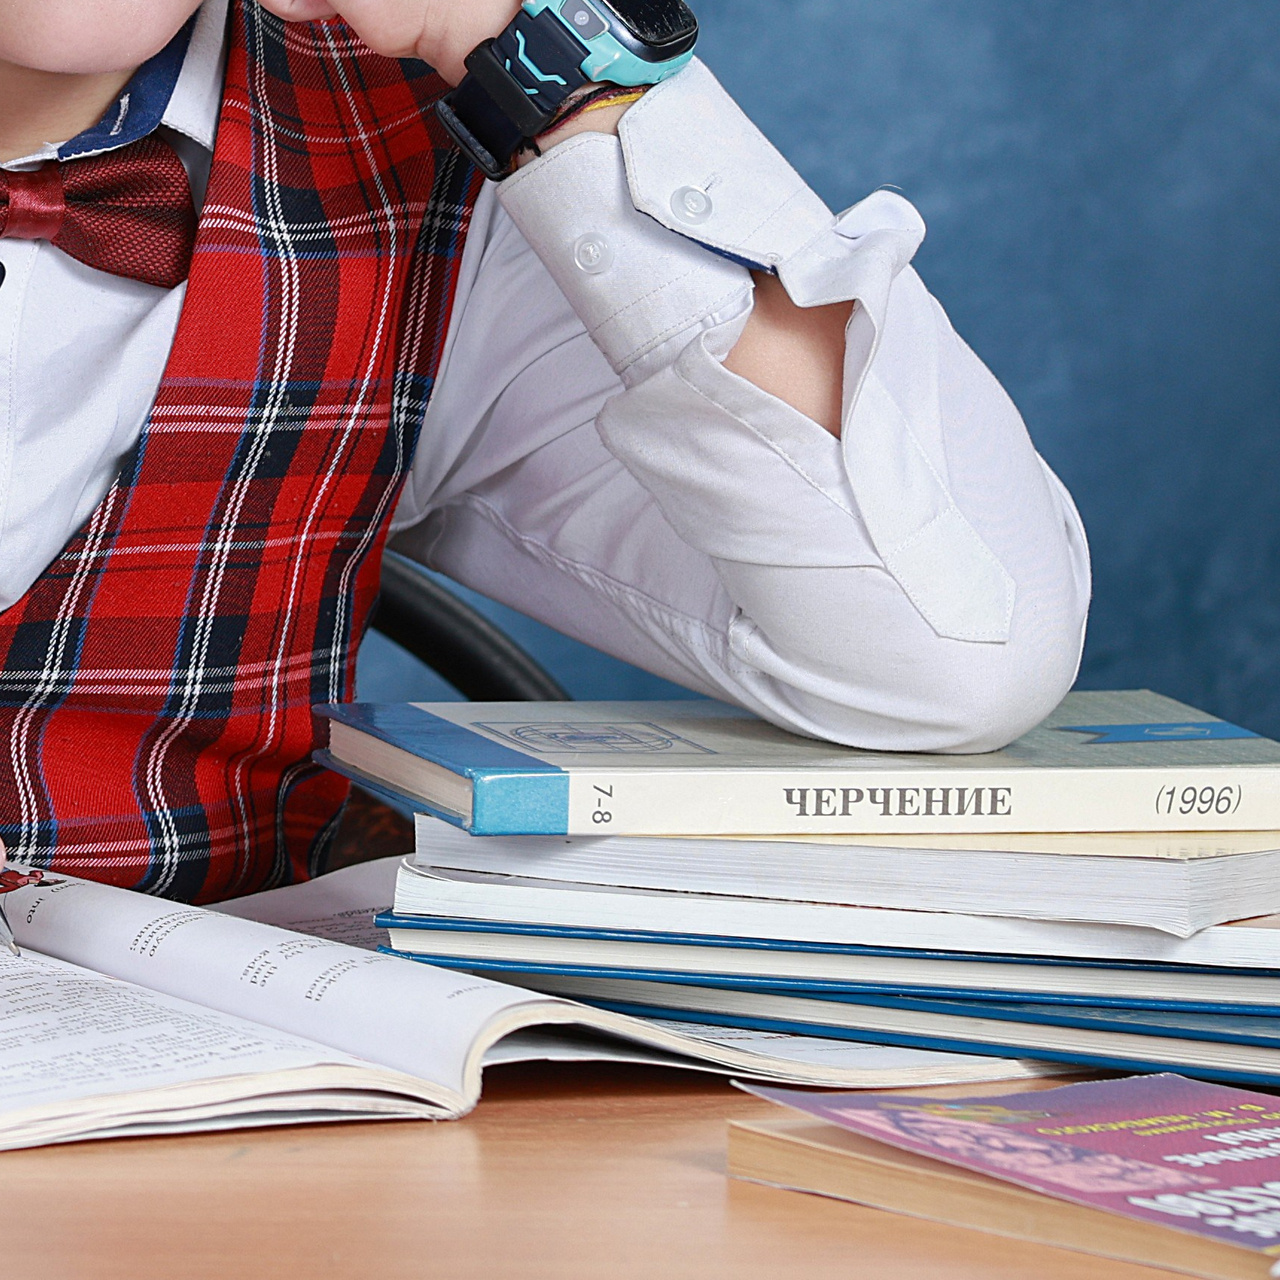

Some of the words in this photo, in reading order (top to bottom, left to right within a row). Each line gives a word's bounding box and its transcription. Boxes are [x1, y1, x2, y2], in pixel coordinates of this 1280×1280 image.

[592, 784, 613, 824] 7-8
[783, 787, 1012, 817] ЧЕРЧЕНИЕ
[1155, 785, 1242, 814] (1996)
[250, 961, 272, 985] had
[260, 966, 278, 987] the
